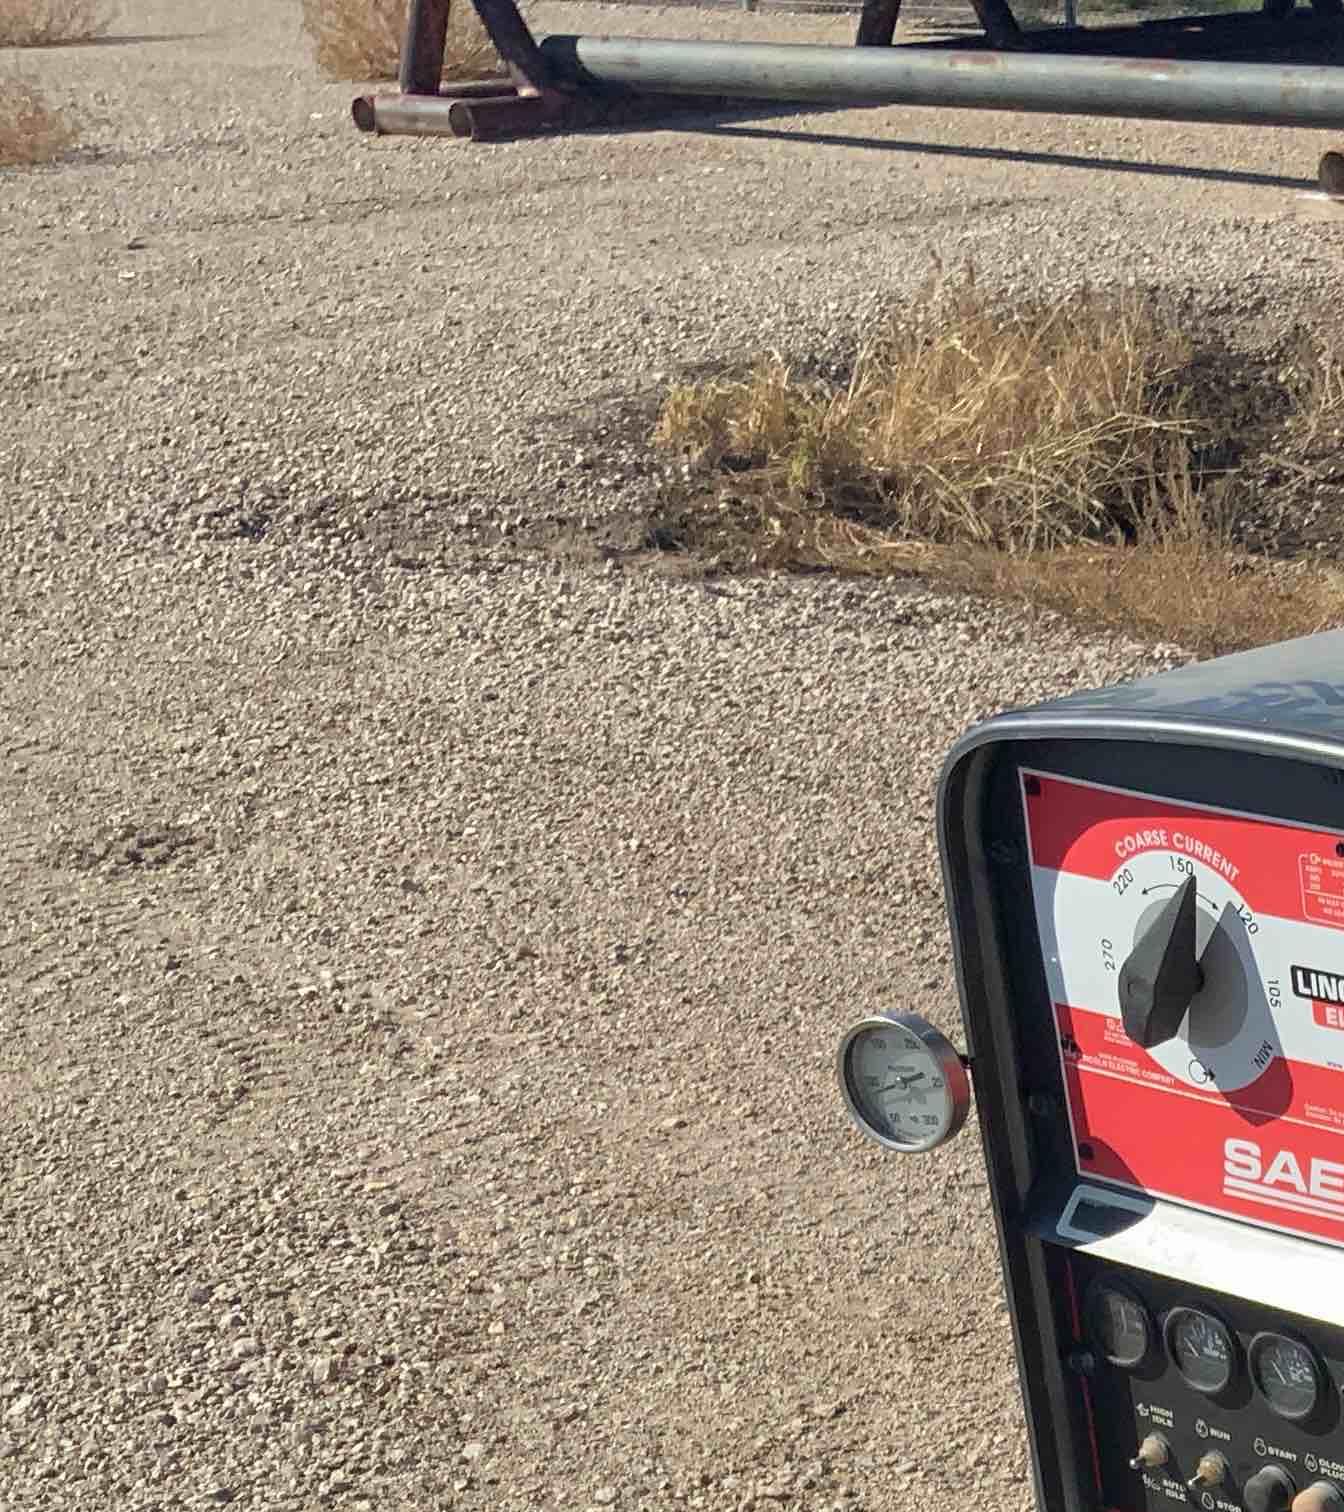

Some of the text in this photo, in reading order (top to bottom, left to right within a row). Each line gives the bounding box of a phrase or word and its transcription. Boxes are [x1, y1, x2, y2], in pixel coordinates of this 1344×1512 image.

[1115, 829, 1240, 882] COARSE CURRENT
[1170, 856, 1194, 876] 150
[1113, 868, 1134, 896] 220
[1236, 903, 1259, 936] 120
[1101, 939, 1116, 971] 270
[1266, 980, 1282, 1009] 105
[1252, 1040, 1274, 1071] MIN
[1209, 1427, 1231, 1441] RUN
[1267, 1446, 1297, 1462] START
